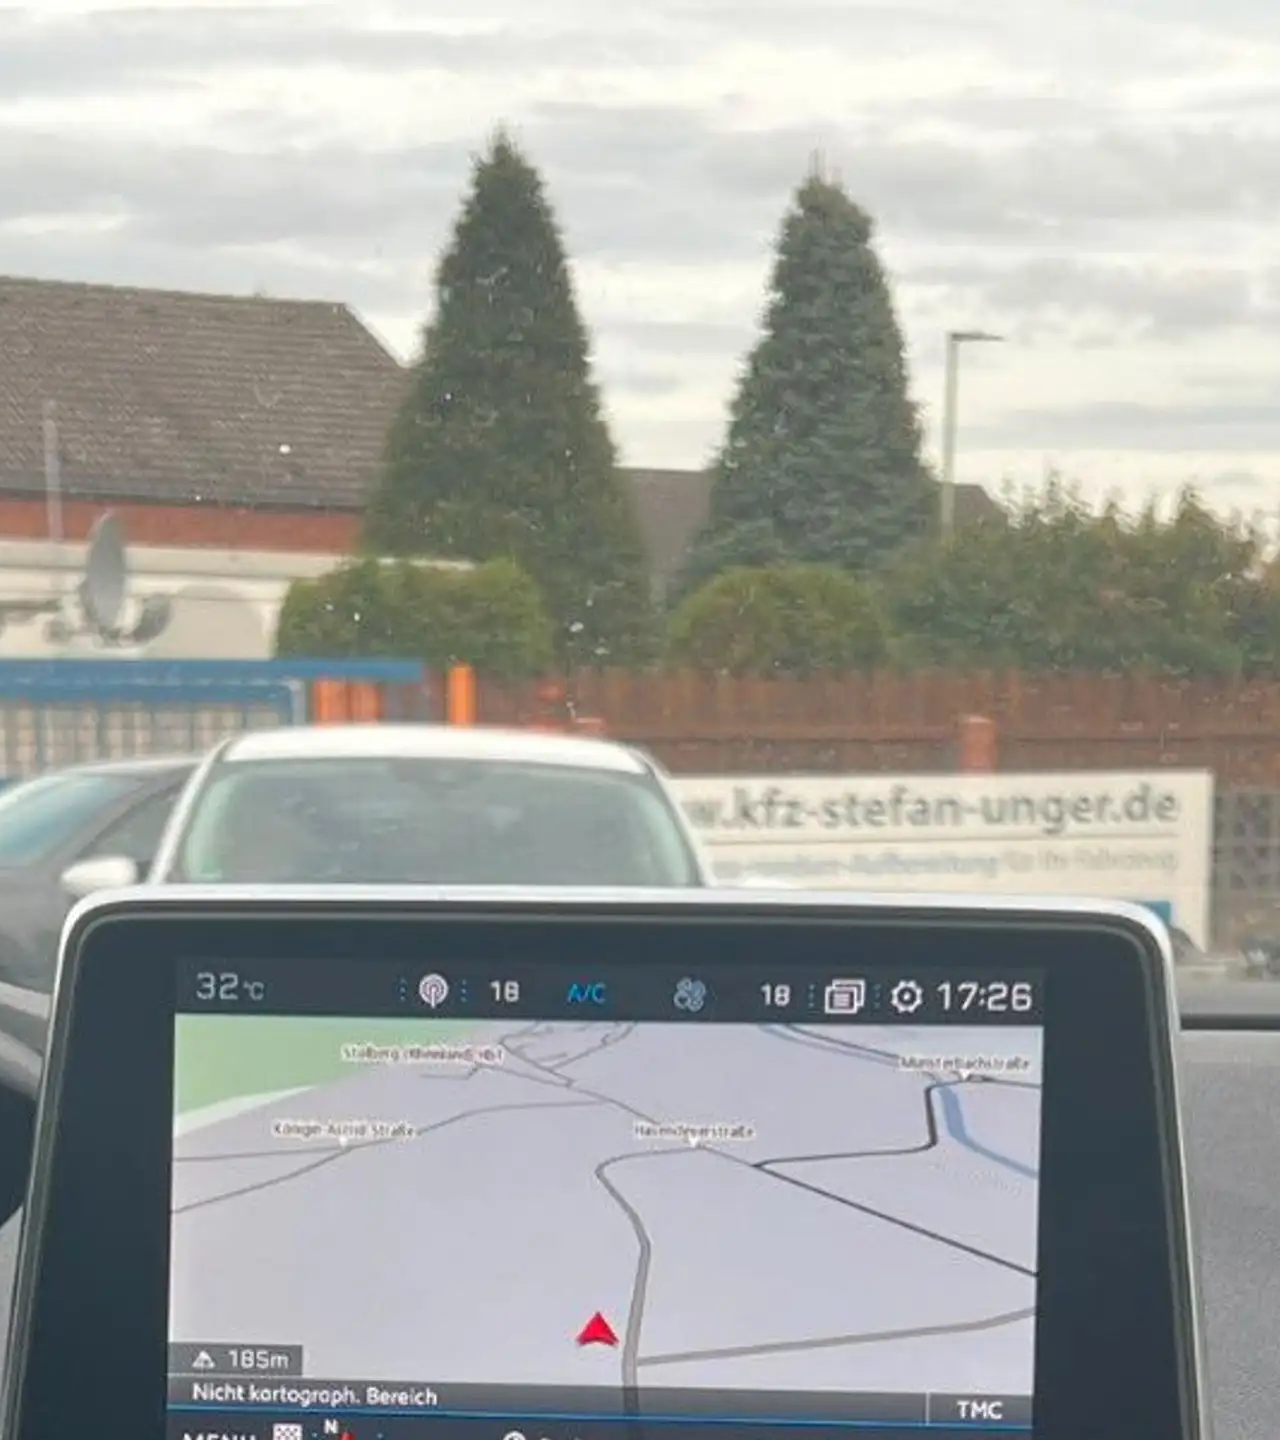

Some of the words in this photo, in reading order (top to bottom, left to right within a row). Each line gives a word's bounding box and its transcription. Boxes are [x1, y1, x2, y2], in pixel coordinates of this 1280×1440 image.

[490, 981, 519, 1002] 18
[567, 983, 606, 1002] A/C
[761, 984, 790, 1006] 18
[936, 982, 1033, 1011] 17:26
[228, 1349, 289, 1369] 185m
[192, 1383, 245, 1401] Nicht
[366, 1388, 438, 1405] Bereich
[957, 1400, 1004, 1420] TMC
[324, 1419, 339, 1434] N
